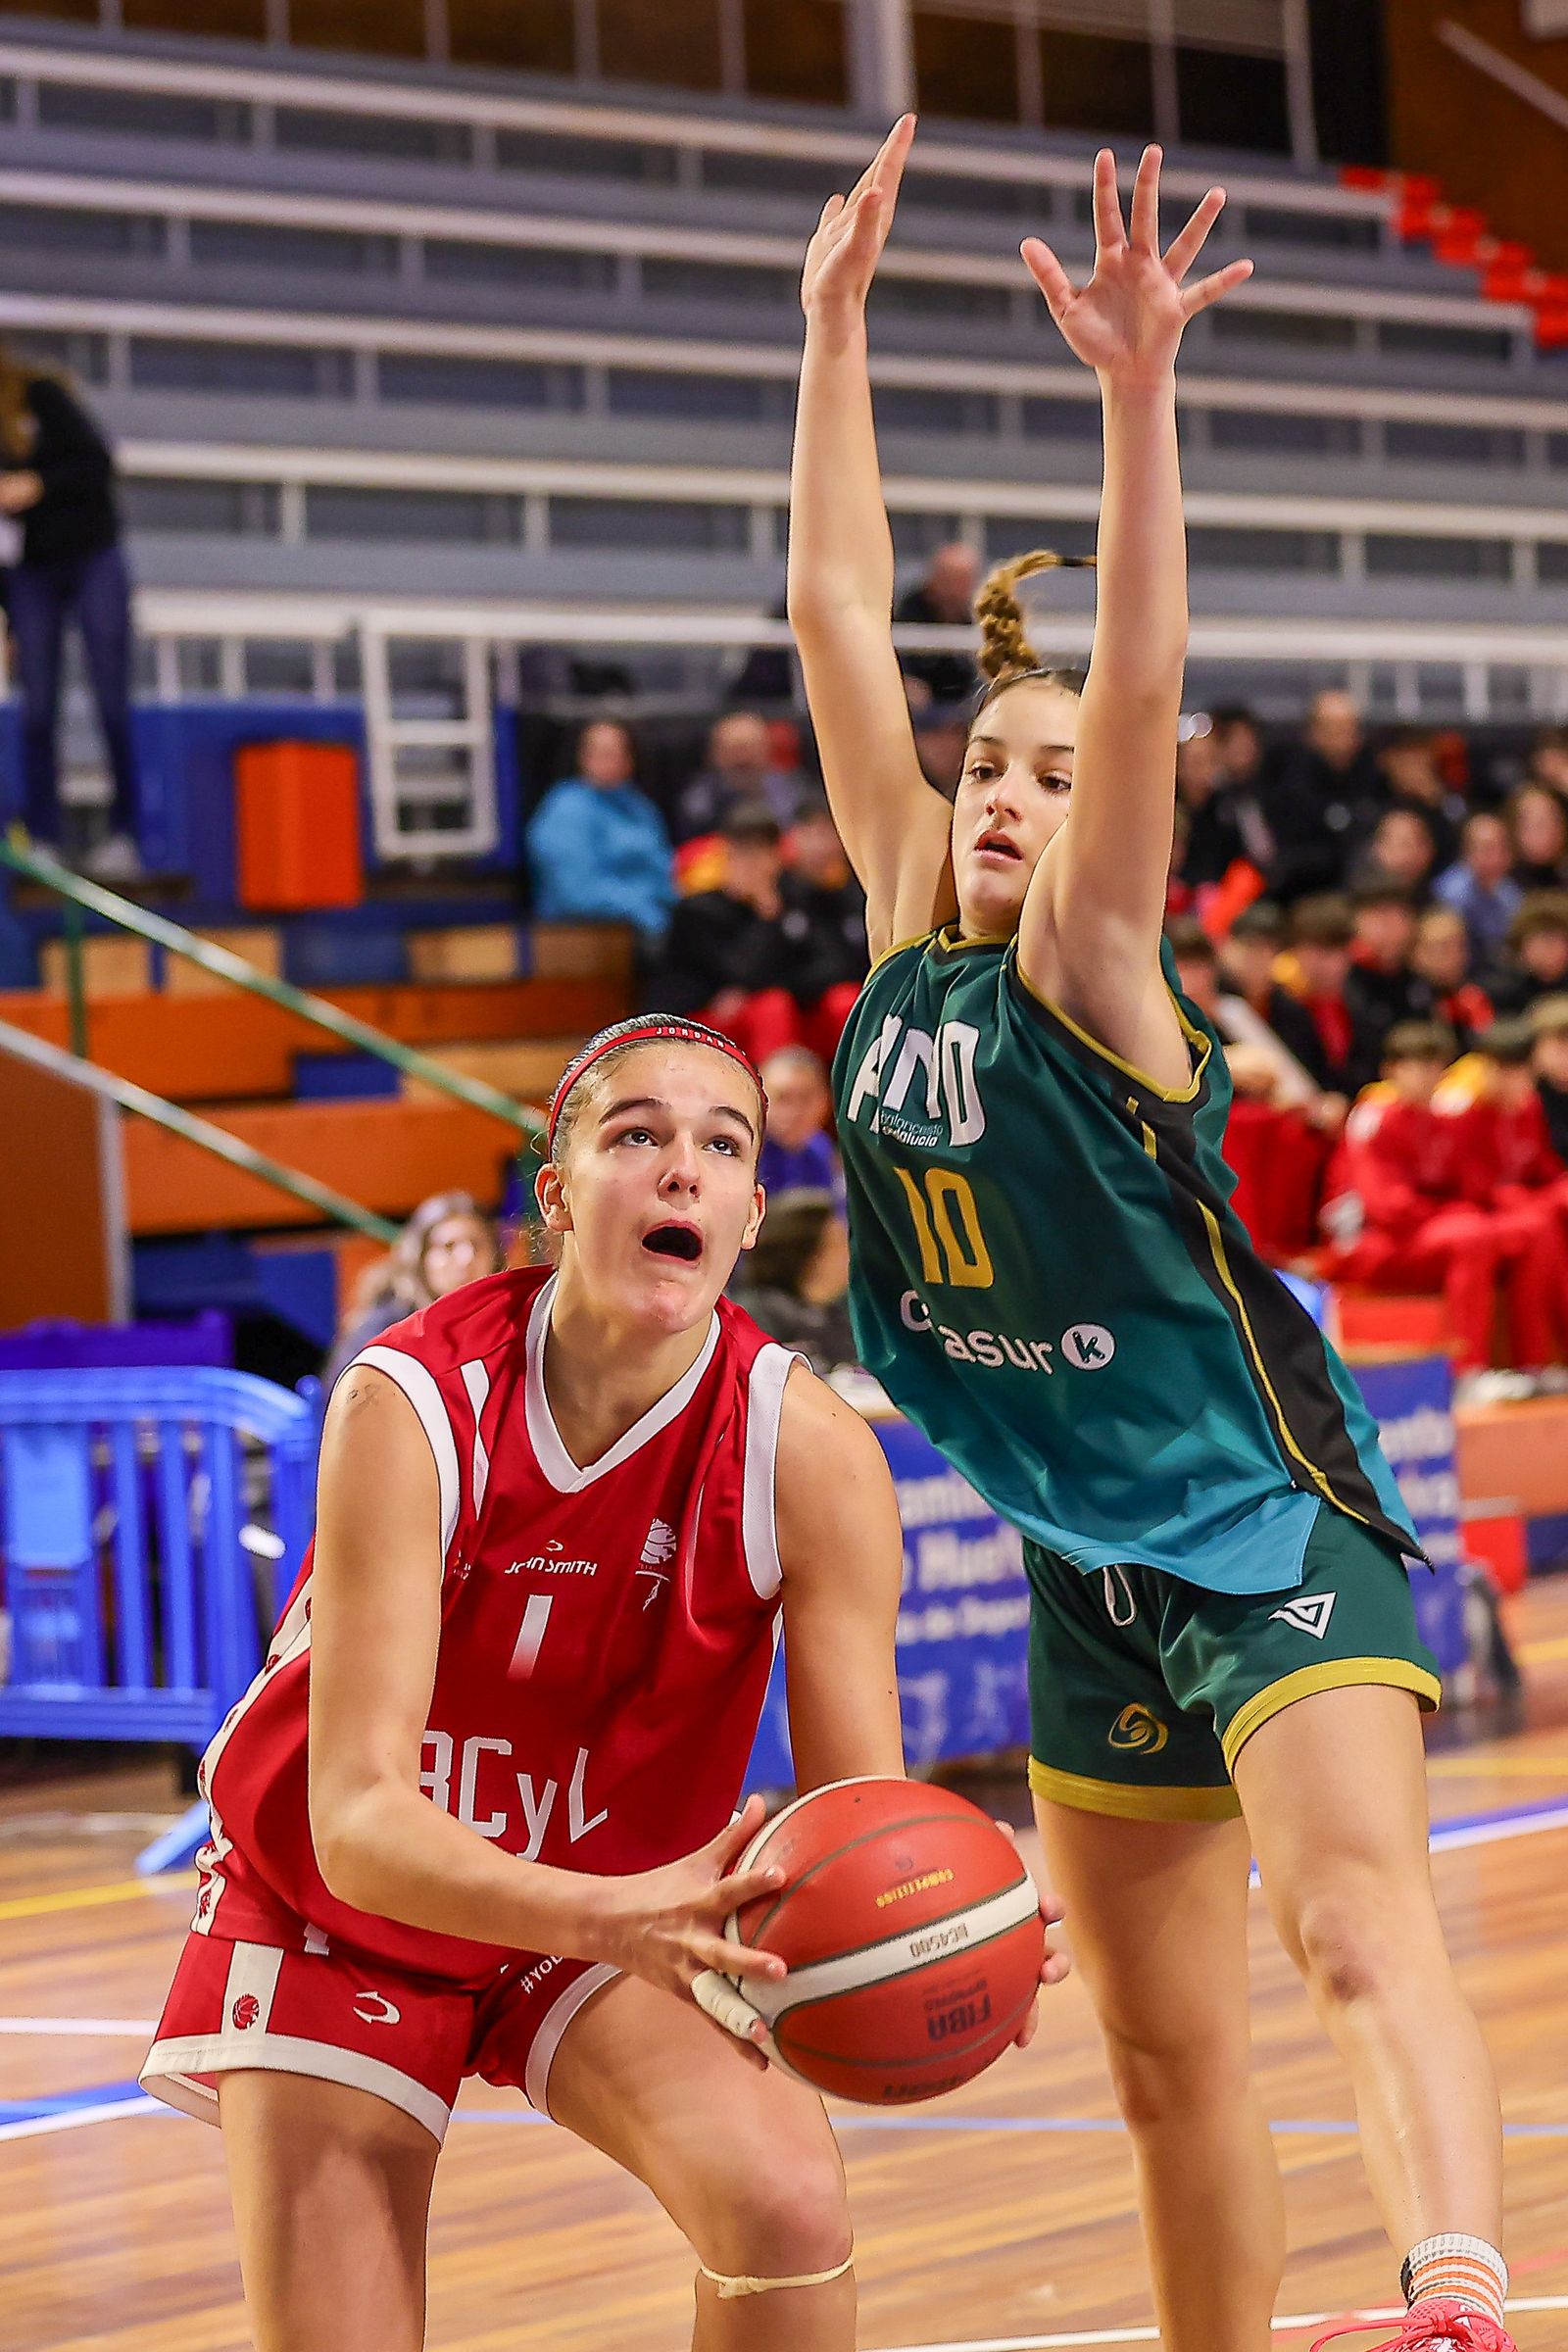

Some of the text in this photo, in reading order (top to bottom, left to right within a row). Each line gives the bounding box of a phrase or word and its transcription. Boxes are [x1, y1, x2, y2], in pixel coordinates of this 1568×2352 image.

[656, 1027, 725, 1049] JORDAN
[847, 1014, 986, 1147] AND
[894, 1167, 995, 1289] 10
[506, 1593, 554, 1680] 1
[926, 1994, 992, 2042] FIBA
